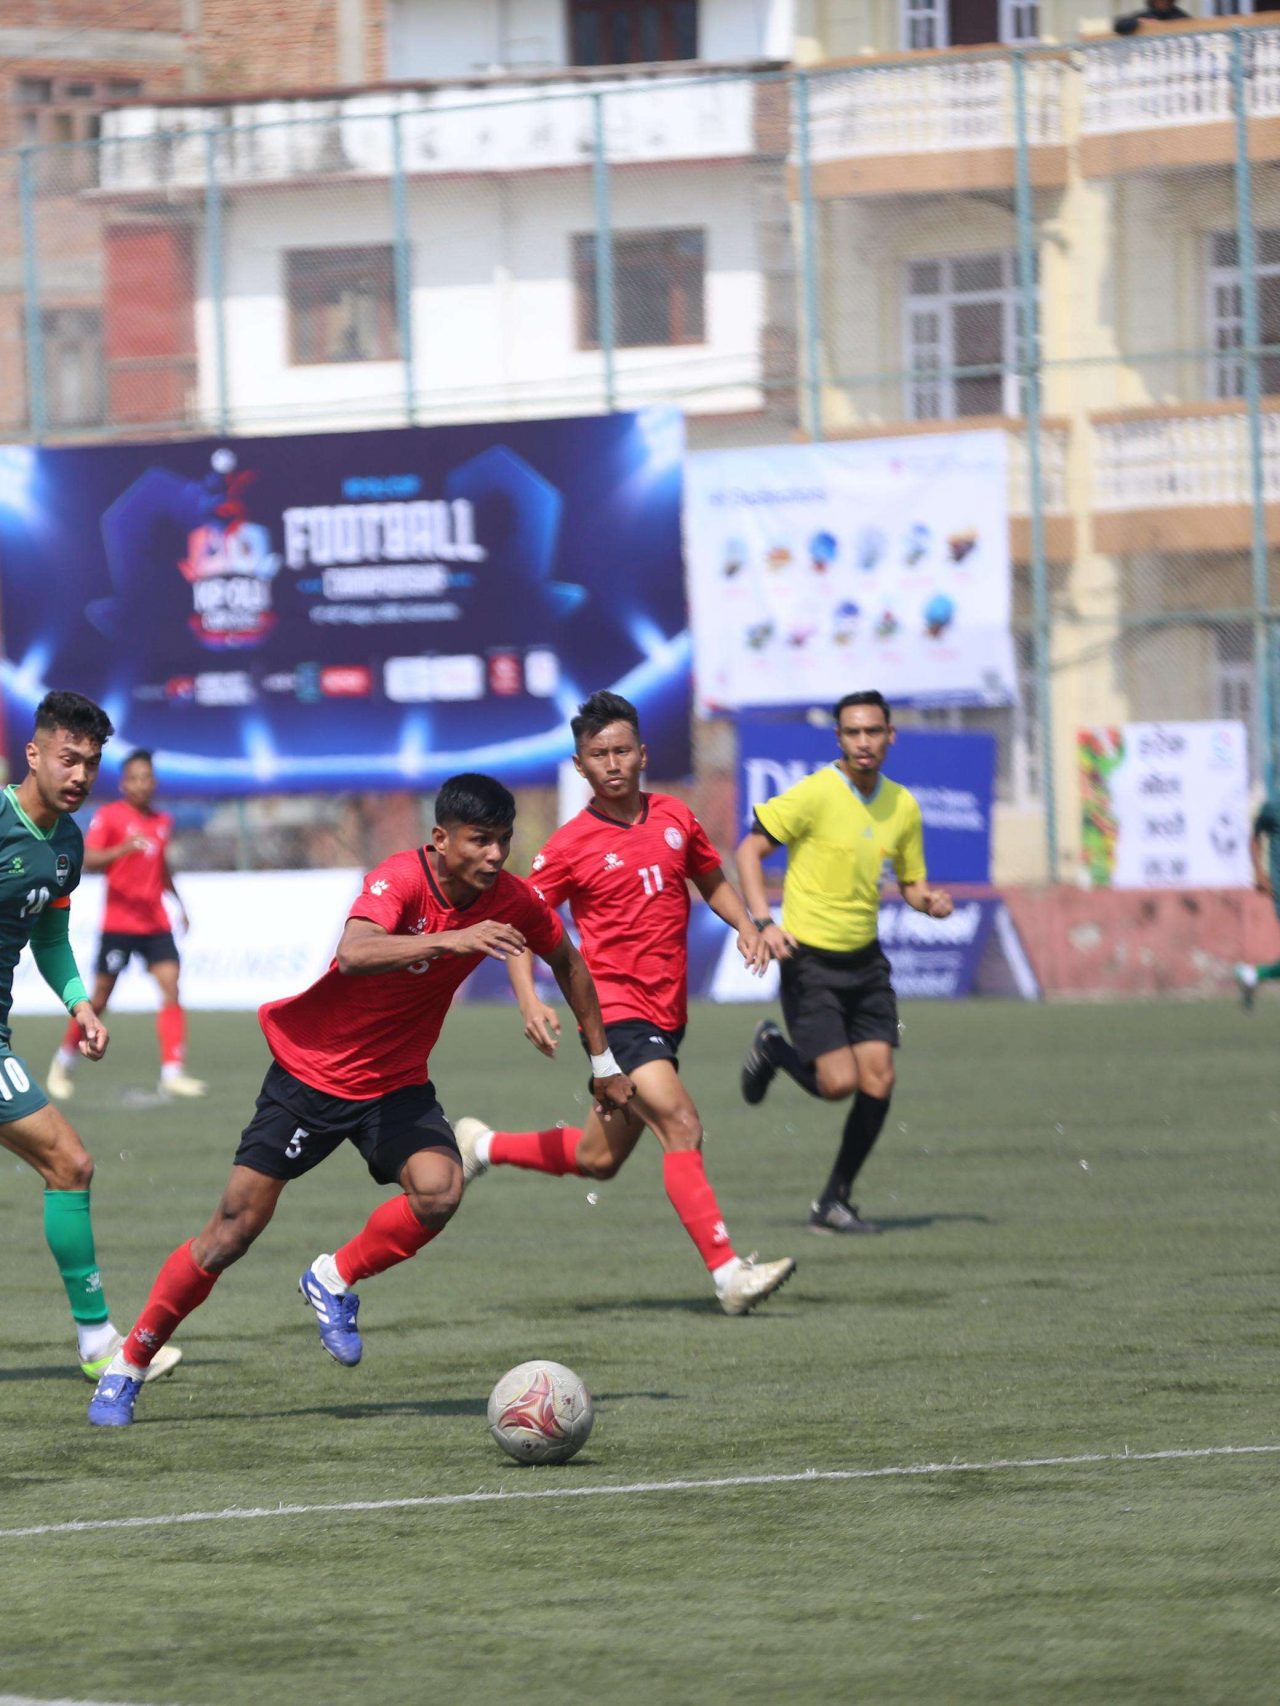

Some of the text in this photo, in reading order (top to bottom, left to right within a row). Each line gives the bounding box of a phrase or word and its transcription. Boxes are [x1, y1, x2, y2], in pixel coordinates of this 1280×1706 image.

[283, 499, 487, 570] FOOTBALL
[638, 863, 664, 896] 11
[20, 886, 50, 919] 10
[284, 1126, 310, 1160] 5
